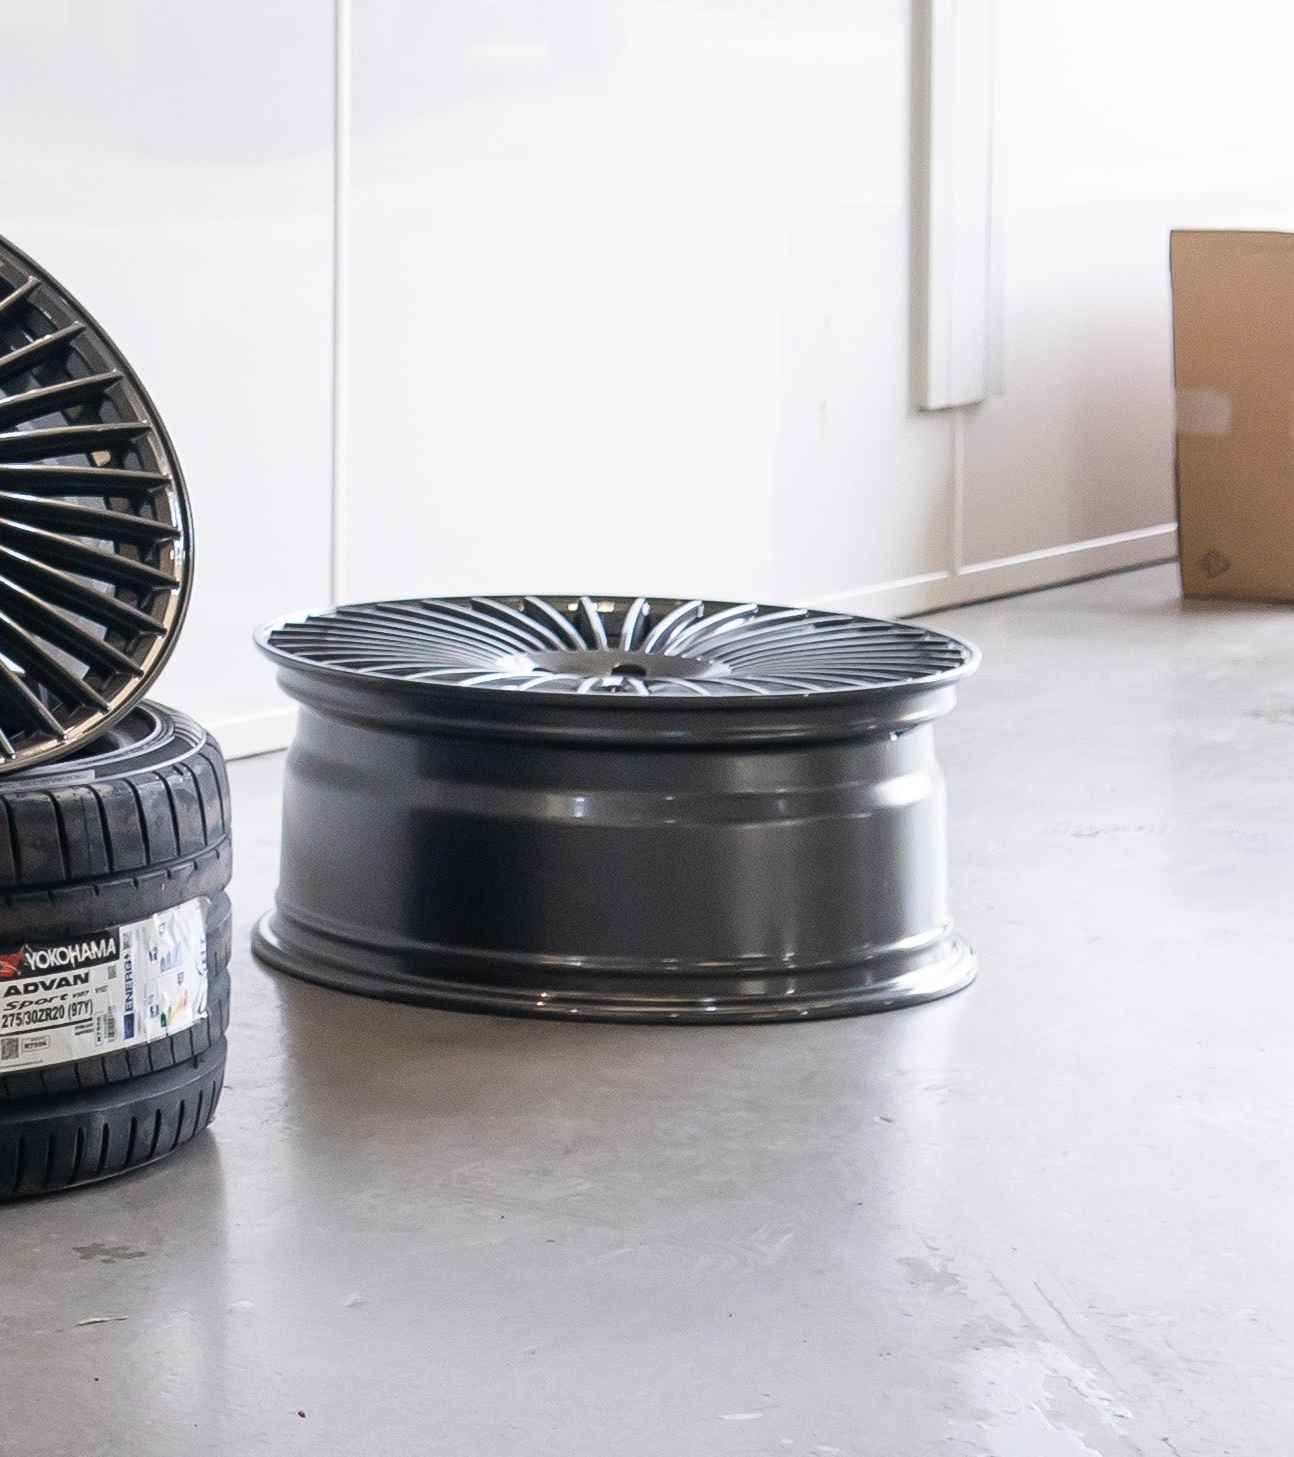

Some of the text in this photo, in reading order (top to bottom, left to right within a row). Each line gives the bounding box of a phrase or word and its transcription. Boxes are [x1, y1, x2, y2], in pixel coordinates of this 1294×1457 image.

[24, 937, 117, 971] YOKOHAMA
[2, 971, 90, 998] ADVAN
[1, 999, 94, 1029] 275/30ZR20 (97Y)
[2, 992, 69, 1012] Sport
